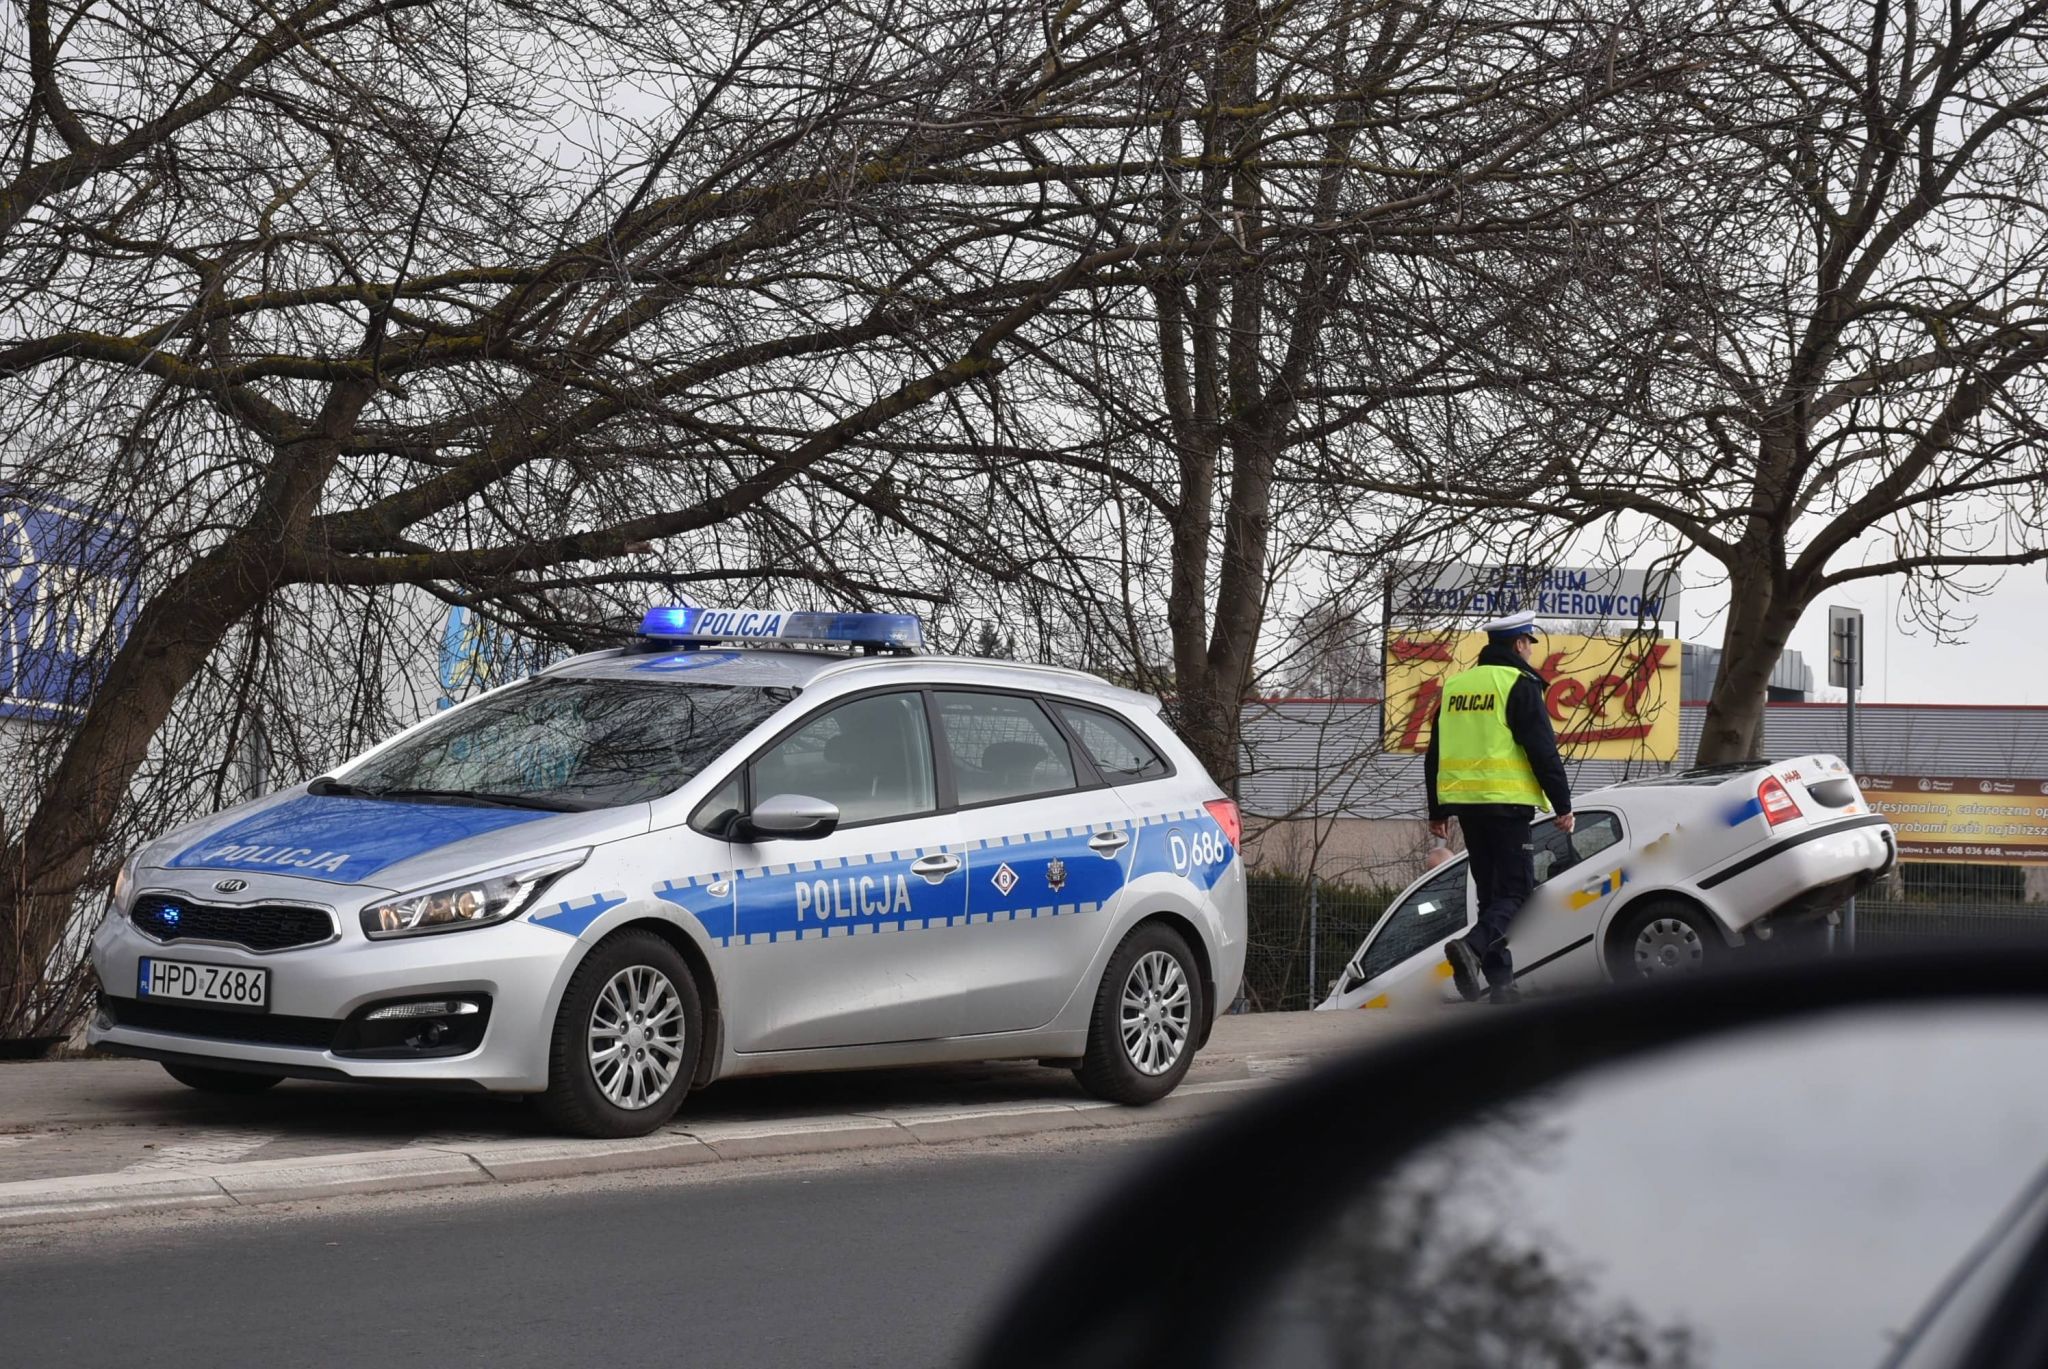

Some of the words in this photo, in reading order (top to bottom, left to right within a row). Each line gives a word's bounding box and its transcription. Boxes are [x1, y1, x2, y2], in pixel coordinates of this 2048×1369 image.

[1538, 593, 1662, 617] KIEROWCÓW
[697, 612, 782, 637] POLICJA
[1448, 694, 1494, 712] POLICJA
[1891, 822, 1946, 833] grobami
[1951, 821, 1981, 833] osób
[203, 846, 351, 872] POLICJA
[1170, 836, 1187, 870] D
[1192, 829, 1224, 866] 686
[1947, 846, 1963, 855] 608
[1965, 846, 1982, 855] 036
[217, 880, 242, 891] KIA
[1001, 874, 1009, 885] R
[795, 874, 912, 922] POLICJA
[140, 981, 148, 989] PL
[152, 963, 197, 996] HPD
[204, 968, 262, 1003] Z686
